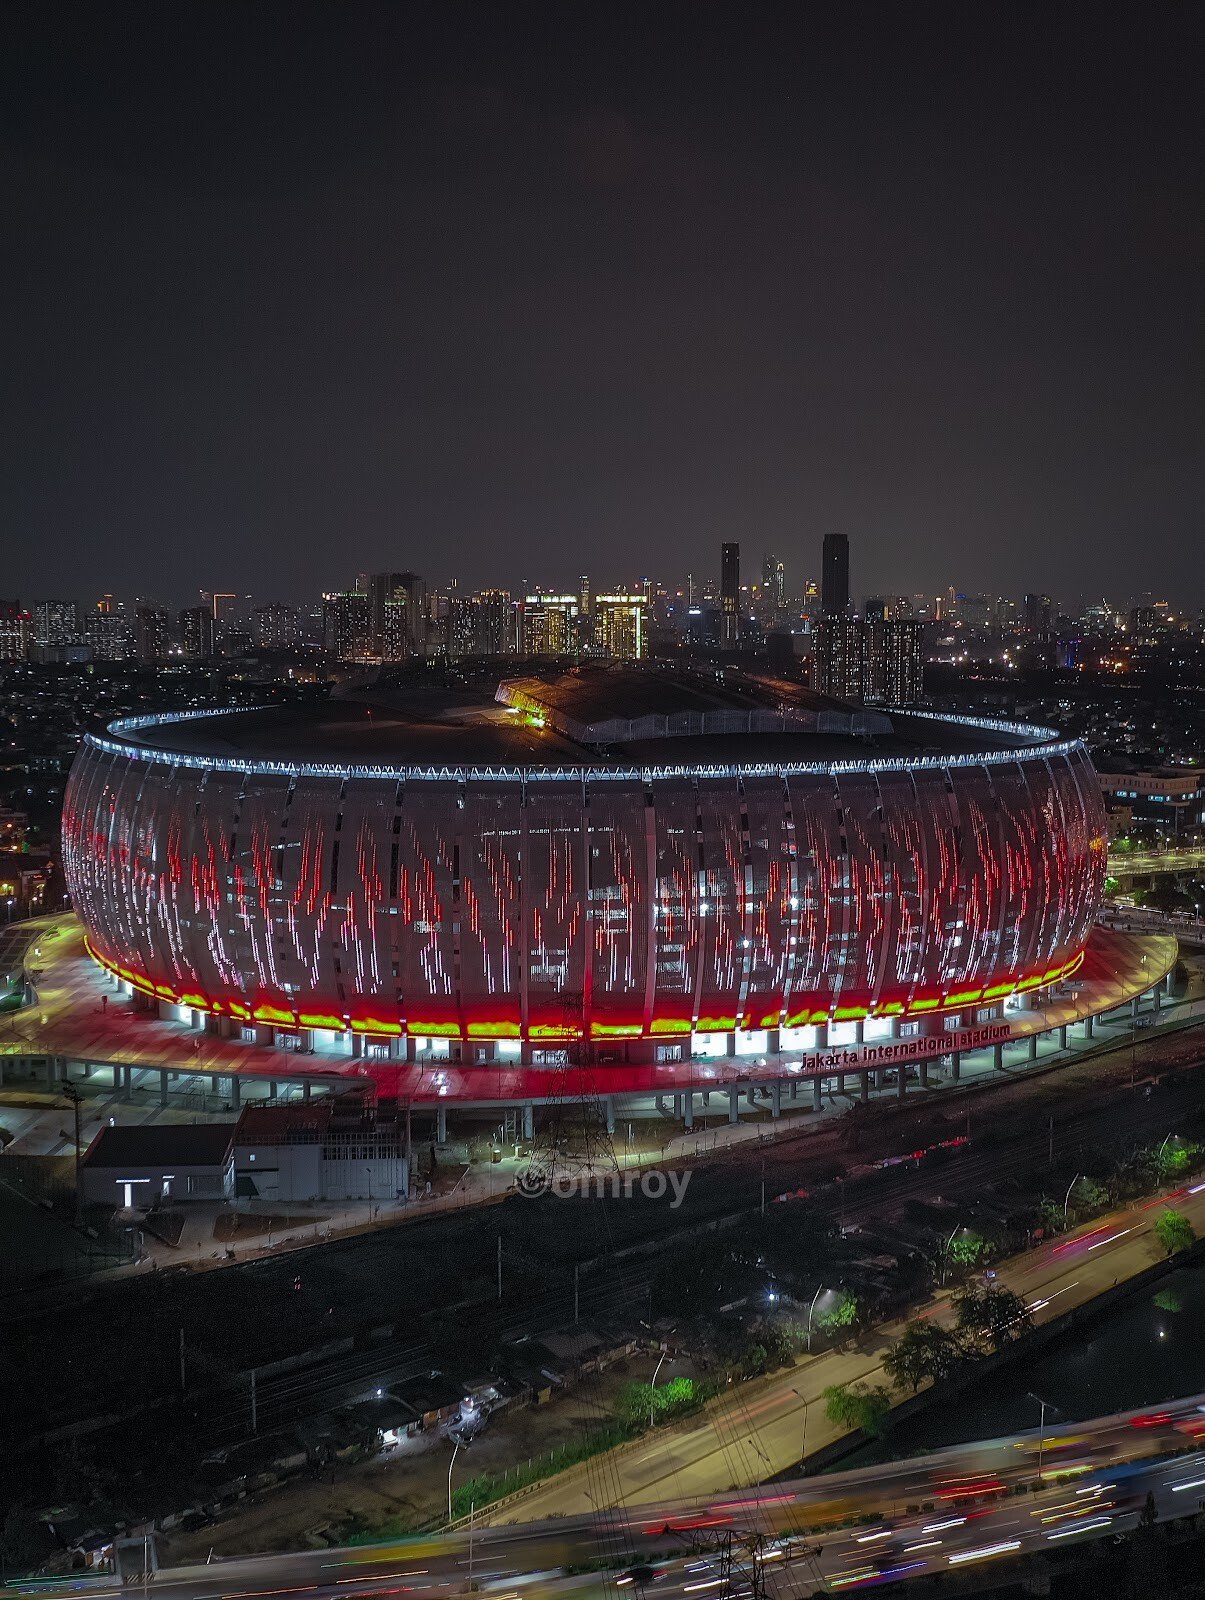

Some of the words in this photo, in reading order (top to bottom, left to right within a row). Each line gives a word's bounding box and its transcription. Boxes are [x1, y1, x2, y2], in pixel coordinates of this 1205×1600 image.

[800, 1053, 859, 1069] jakarta
[863, 1034, 957, 1061] international
[960, 1023, 1011, 1045] stadium
